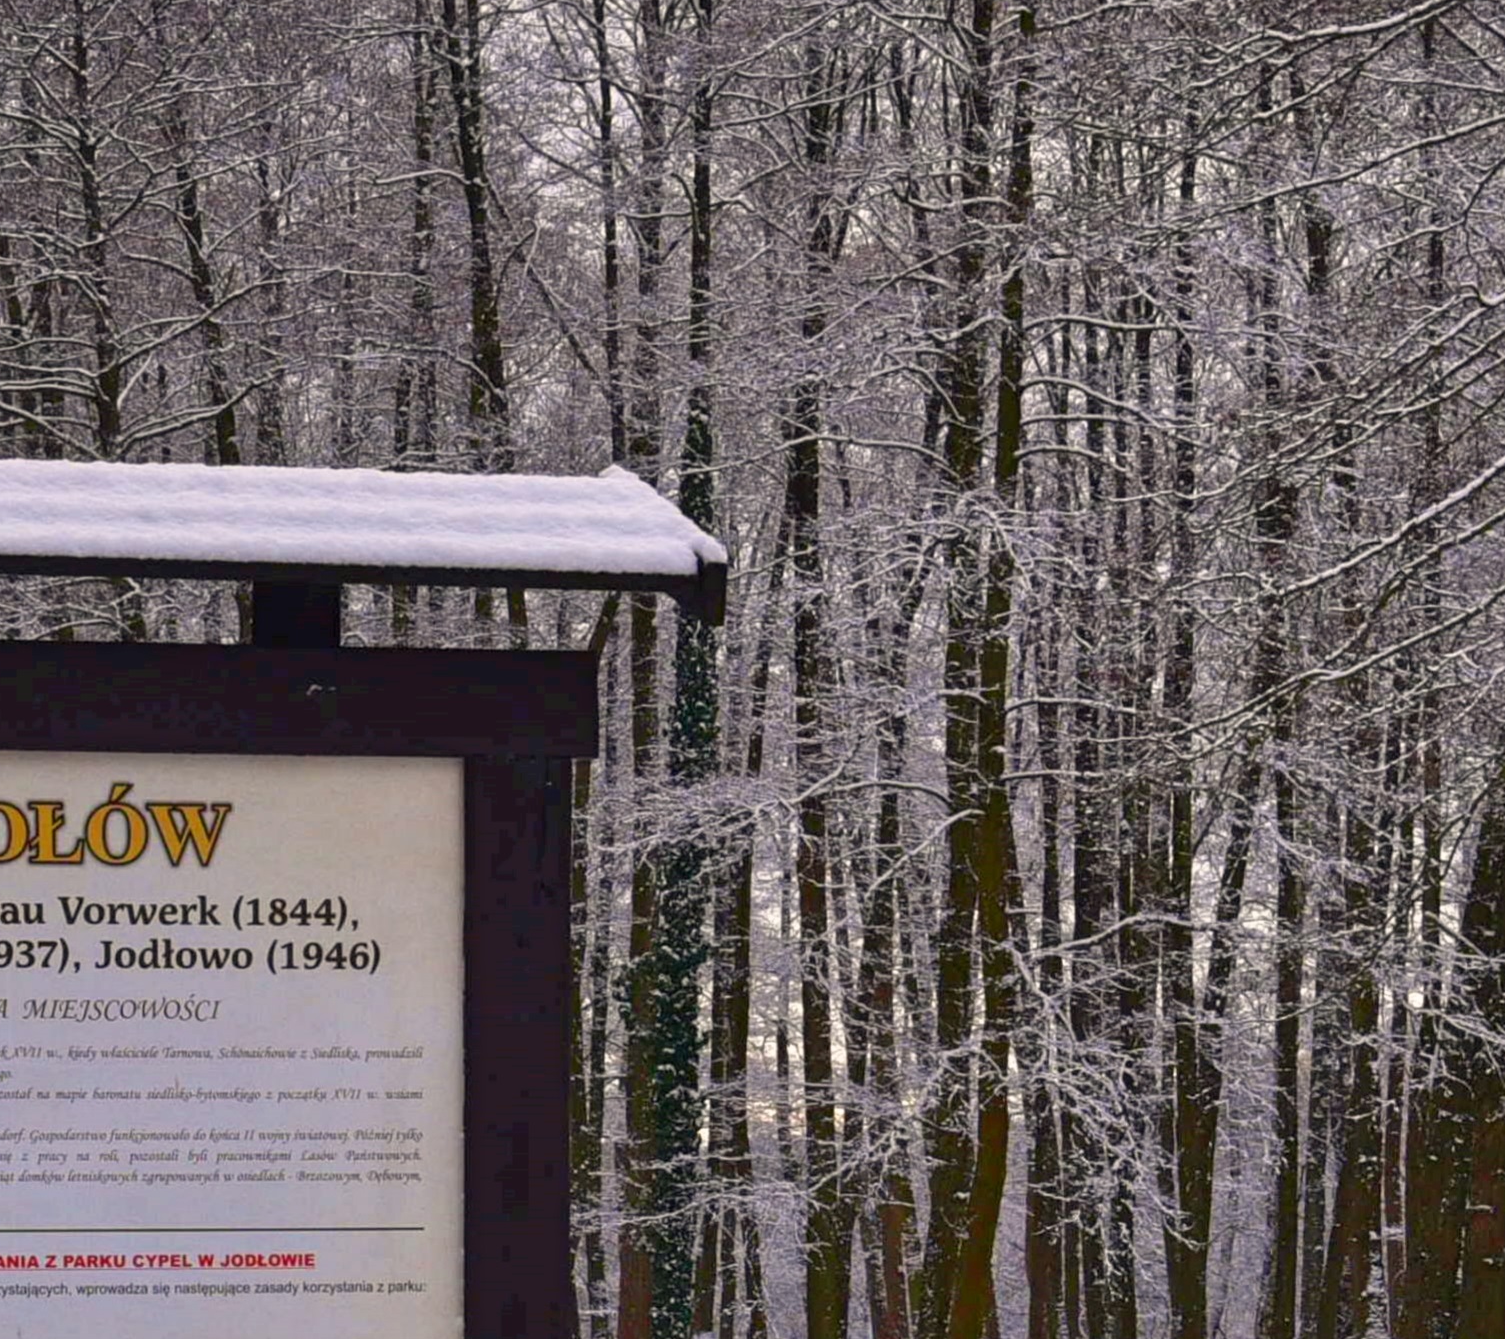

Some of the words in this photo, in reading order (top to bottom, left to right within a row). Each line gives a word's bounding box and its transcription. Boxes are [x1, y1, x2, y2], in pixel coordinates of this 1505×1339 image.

[58, 895, 221, 925] Vorwerk
[232, 896, 359, 931] (1844),
[95, 939, 253, 970] Jodłowo
[267, 940, 381, 974] (1946)
[22, 994, 221, 1022] MIEJSCOWOŚCI
[45, 1254, 57, 1268] Z
[63, 1254, 126, 1268] PARKU
[132, 1253, 191, 1267] CYPEL
[198, 1253, 214, 1267] W
[220, 1253, 315, 1267] JODŁOWIE
[76, 1281, 148, 1298] wprowadza
[152, 1281, 169, 1298] się
[174, 1281, 250, 1298] następujące
[254, 1280, 299, 1297] zasady
[302, 1280, 374, 1297] korzystania
[377, 1283, 384, 1293] z
[387, 1280, 427, 1297] parku:
